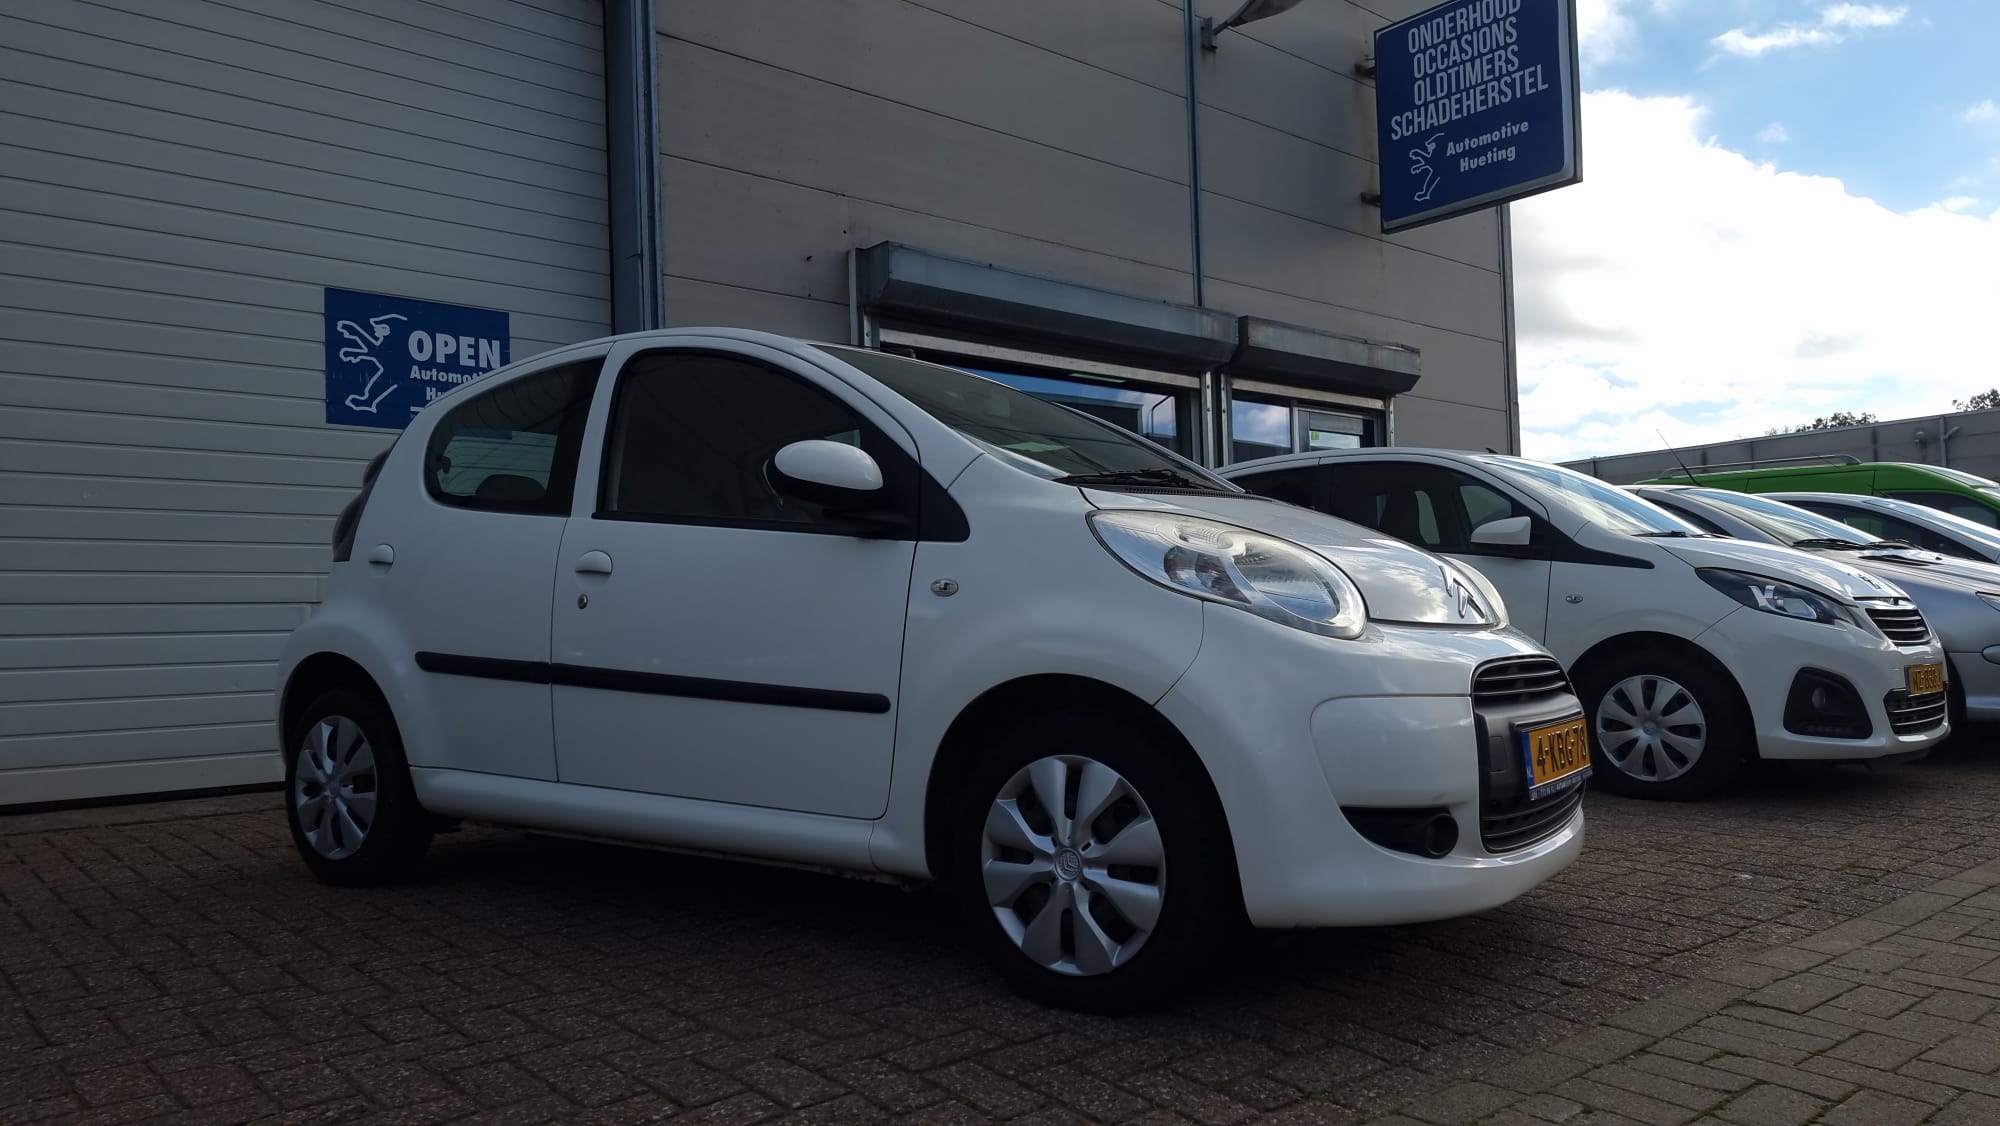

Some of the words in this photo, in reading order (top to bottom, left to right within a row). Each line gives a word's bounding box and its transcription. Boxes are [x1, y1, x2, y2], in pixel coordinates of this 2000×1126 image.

[1408, 0, 1521, 54] ONDERHOUD
[1413, 16, 1518, 79] OCCASIONS
[1413, 44, 1519, 106] OLDTIMERS
[1391, 64, 1549, 141] SCHADEHERSTEL
[1446, 120, 1529, 157] Automotive
[1460, 146, 1516, 173] Hueting
[408, 330, 501, 369] OPEN
[1537, 724, 1587, 777] 4-KBG-78
